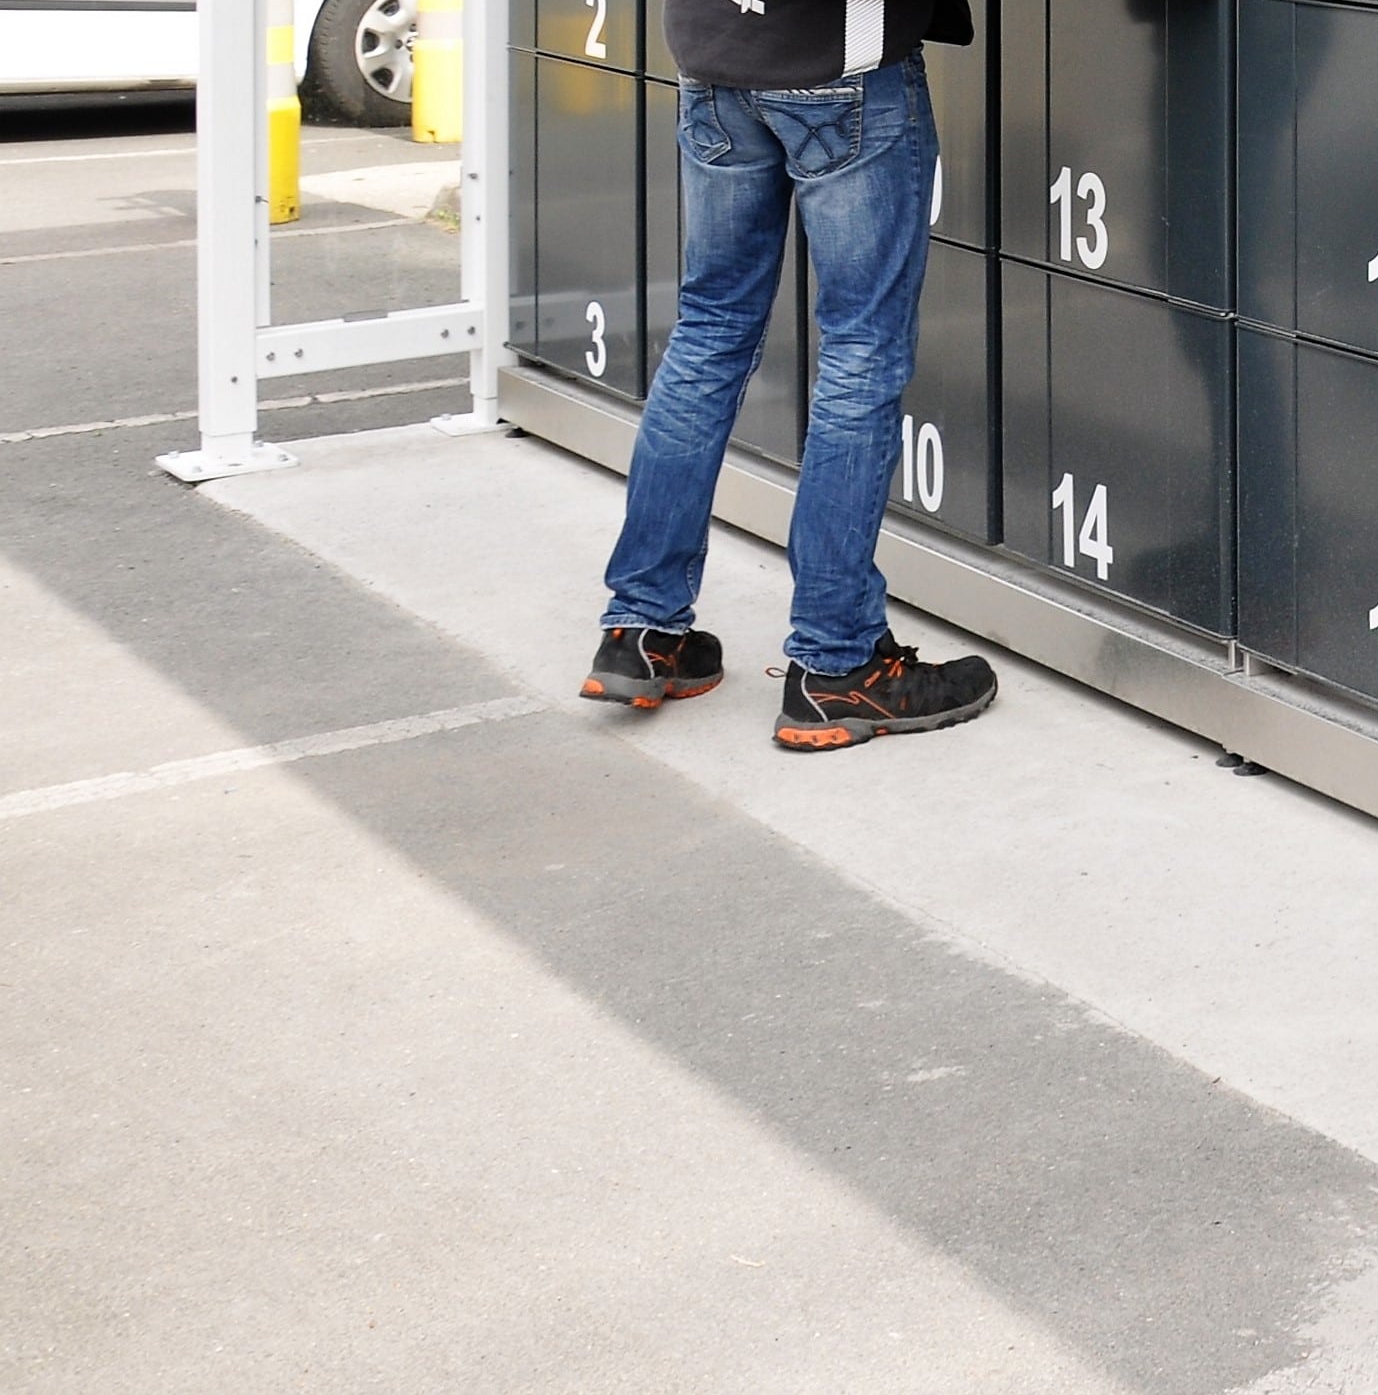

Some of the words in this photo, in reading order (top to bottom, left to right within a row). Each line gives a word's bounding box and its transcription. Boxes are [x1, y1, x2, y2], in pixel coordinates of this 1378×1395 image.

[1050, 166, 1109, 270] 13
[584, 301, 607, 377] 3
[901, 414, 944, 513] 10
[1052, 472, 1114, 581] 14
